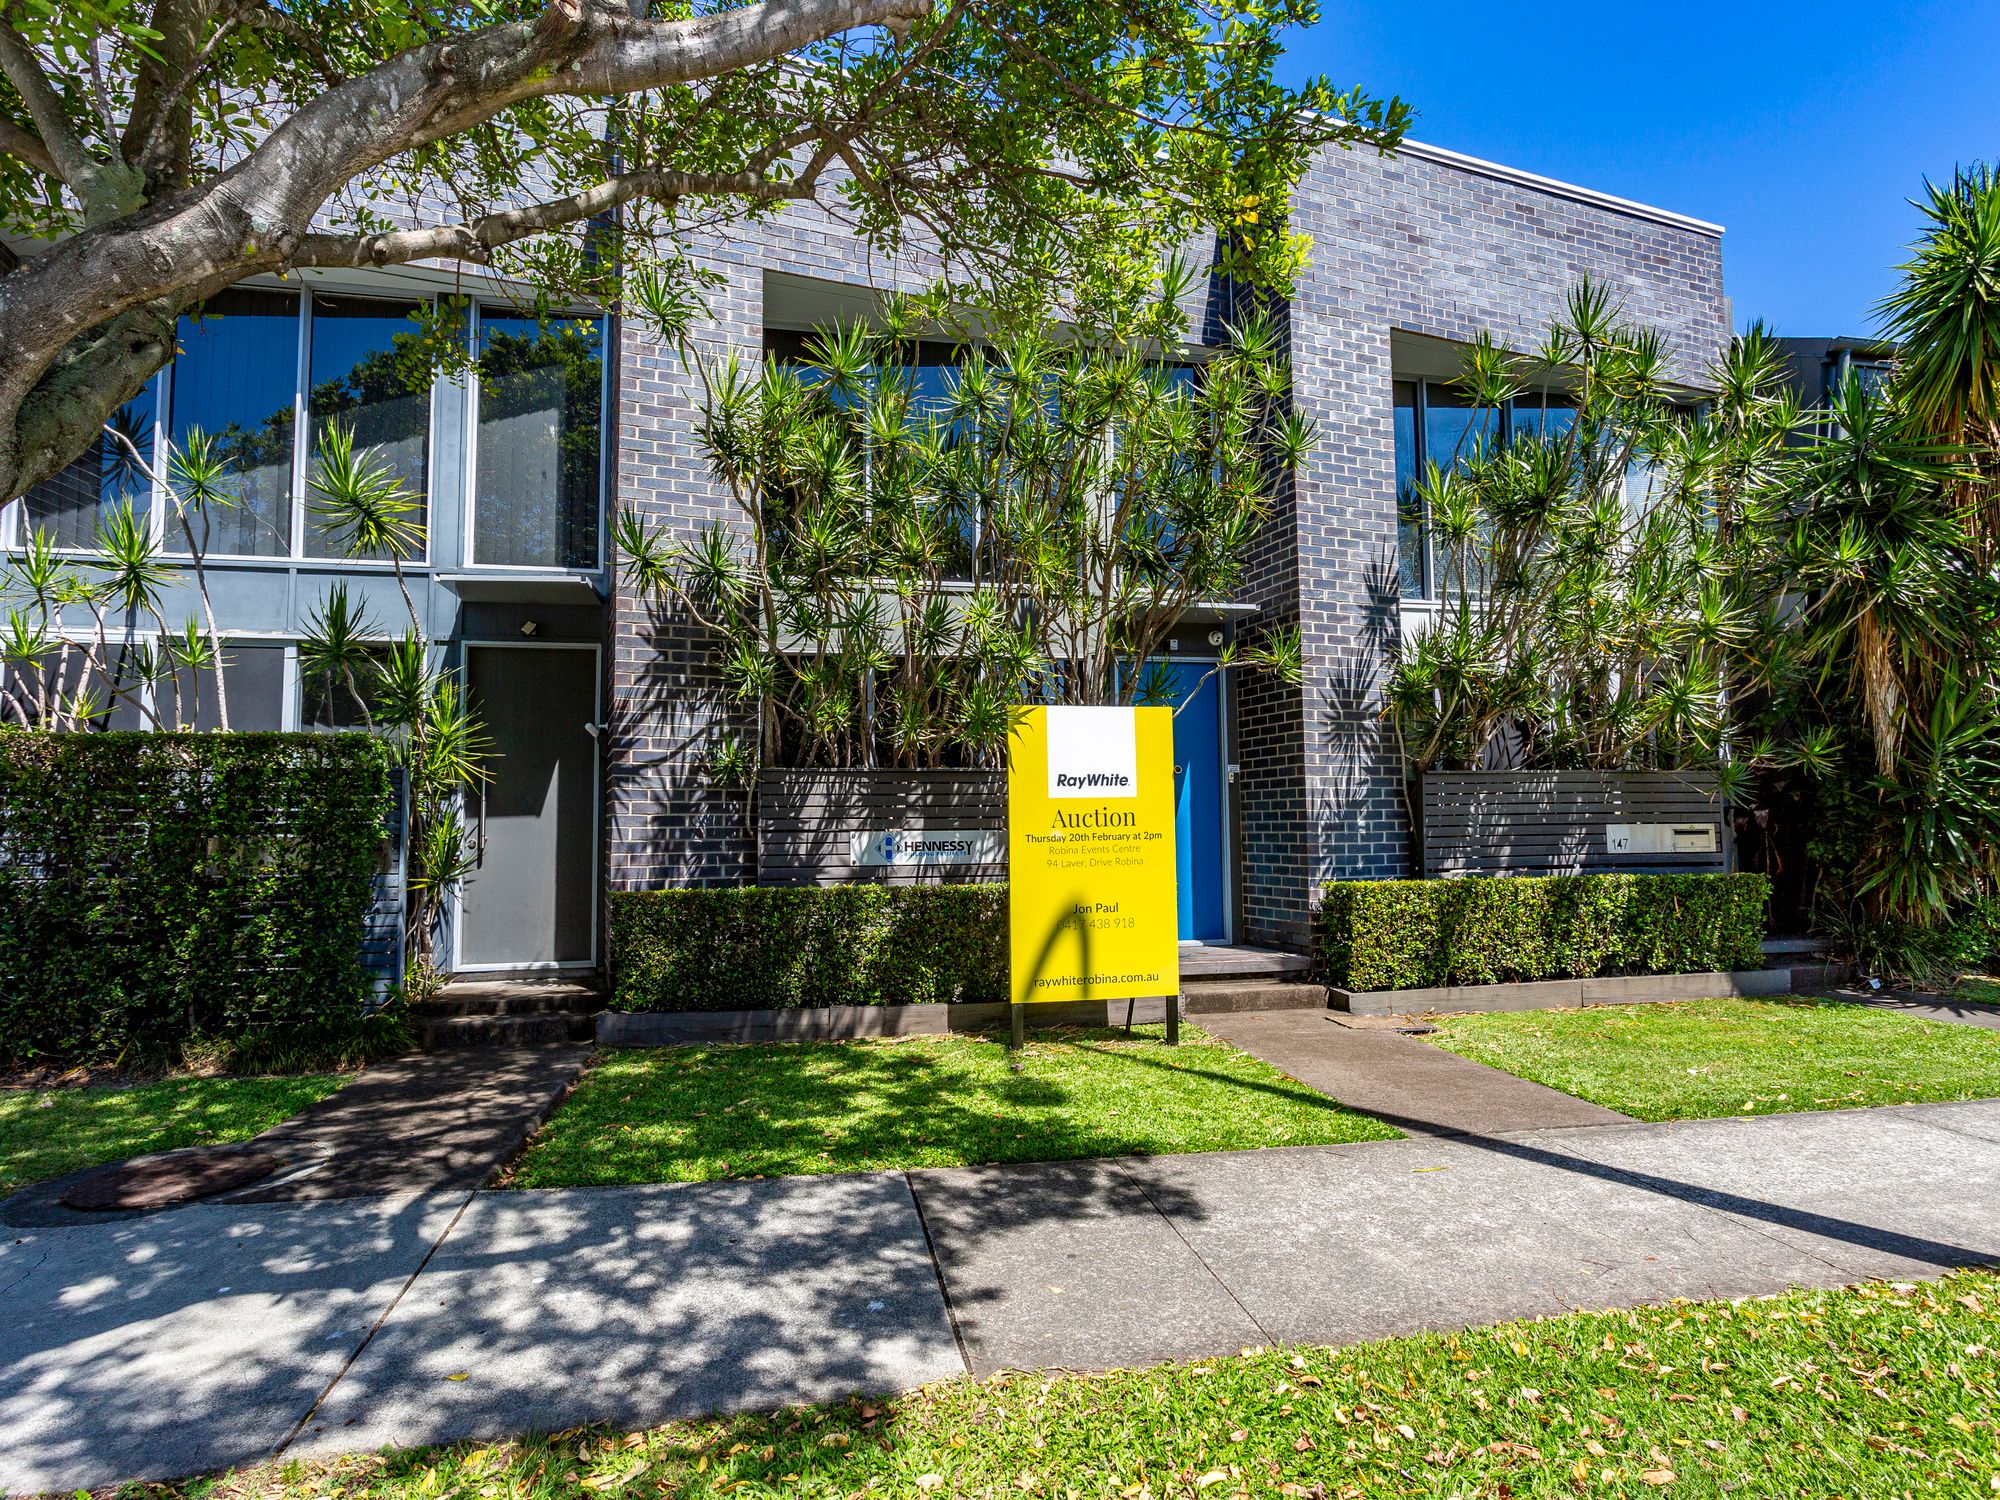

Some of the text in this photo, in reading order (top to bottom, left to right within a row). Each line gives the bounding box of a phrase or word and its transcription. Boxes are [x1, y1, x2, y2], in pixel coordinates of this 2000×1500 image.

[1052, 807, 1136, 828] Auction
[1026, 831, 1162, 843] Thursday 20th February at 2pm
[904, 841, 973, 855] HENNESSY
[1049, 845, 1141, 854] Robina Events Centre
[1612, 838, 1628, 850] 147
[1047, 859, 1058, 867] 94
[1090, 858, 1112, 866] Drive
[1115, 857, 1143, 866] Robina
[1073, 902, 1119, 914] Jon Paul
[1057, 917, 1135, 931] 0417 438 918
[1034, 973, 1159, 988] raywhiterobina.com.au
